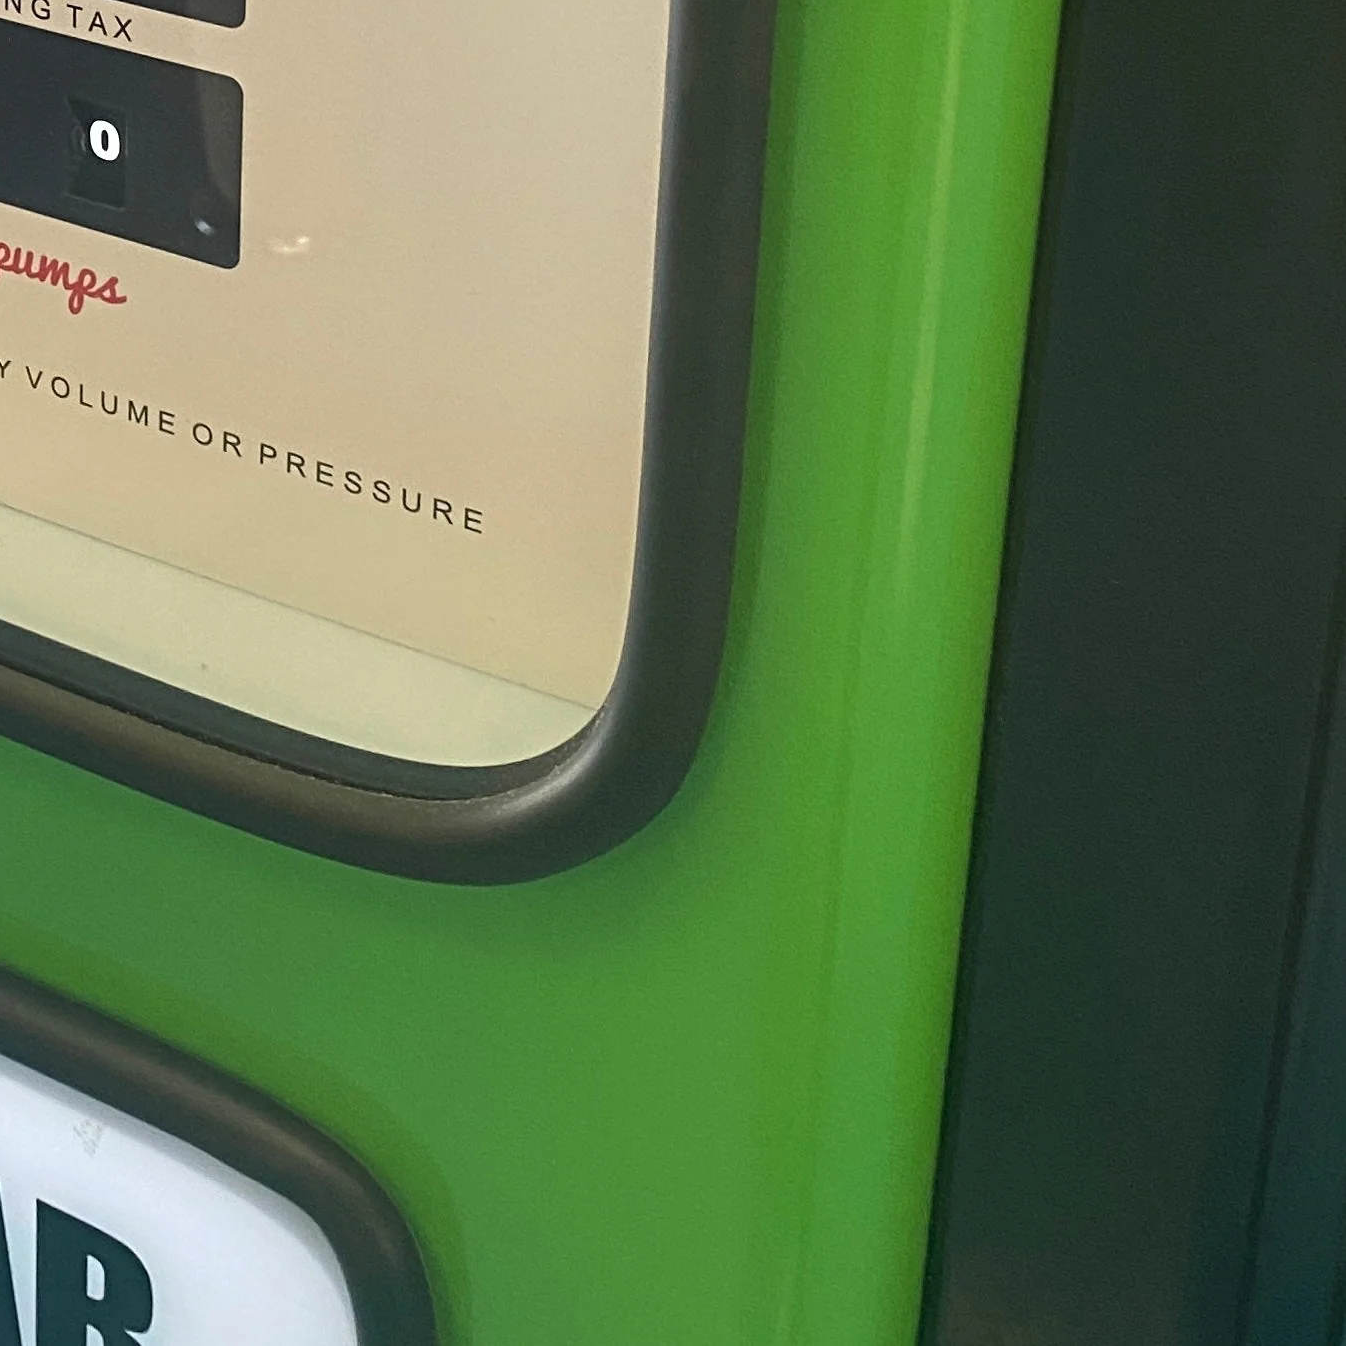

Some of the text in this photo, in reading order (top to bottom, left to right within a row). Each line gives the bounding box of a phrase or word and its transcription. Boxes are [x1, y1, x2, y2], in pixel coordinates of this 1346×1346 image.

[65, 3, 135, 44] TAX
[24, 364, 177, 437] VOLUME
[191, 421, 244, 459] OR
[258, 441, 484, 536] PRESSURE
